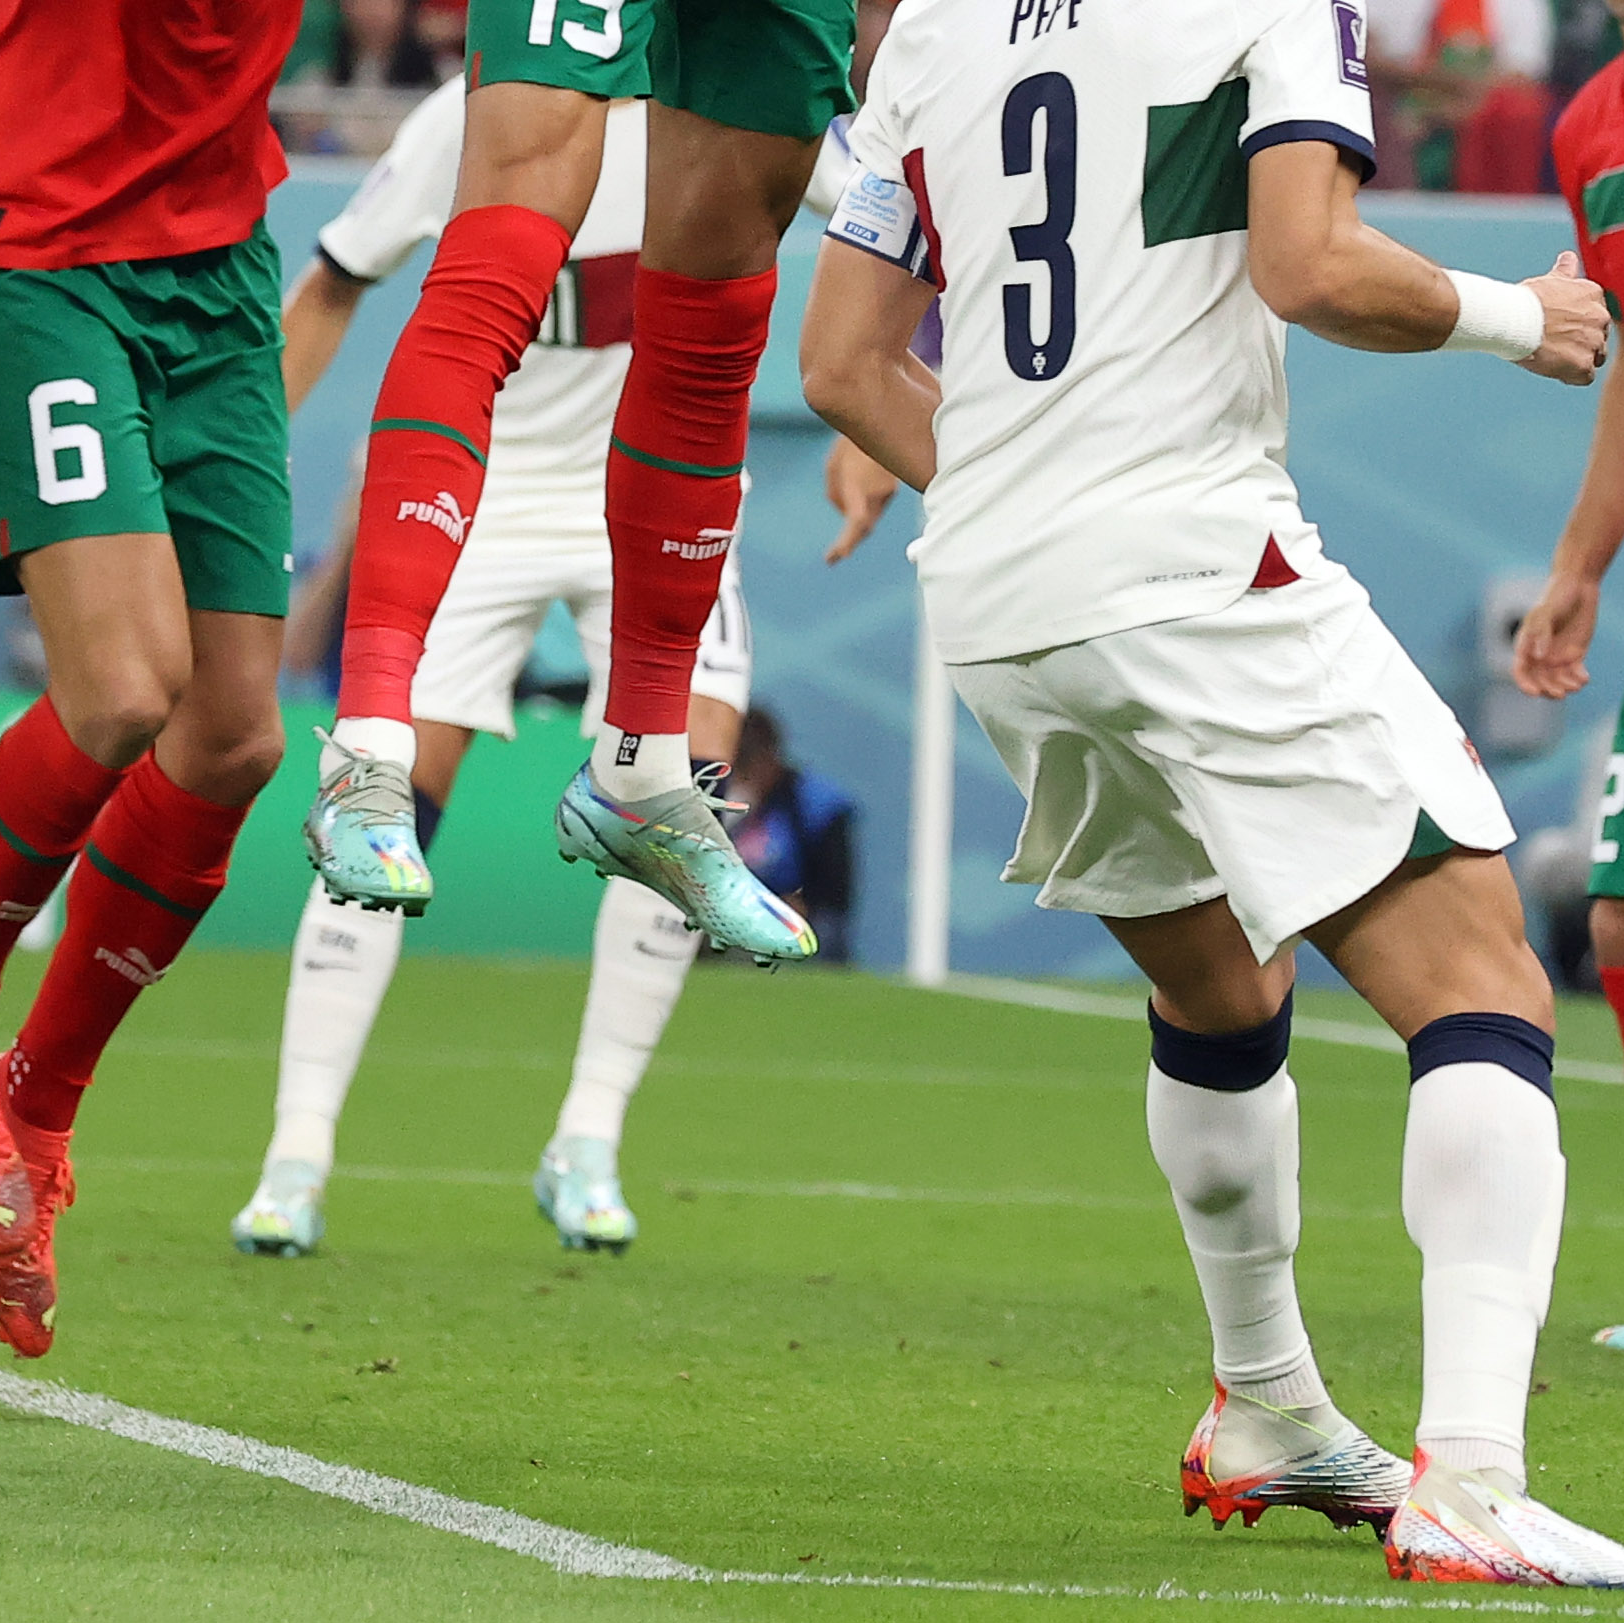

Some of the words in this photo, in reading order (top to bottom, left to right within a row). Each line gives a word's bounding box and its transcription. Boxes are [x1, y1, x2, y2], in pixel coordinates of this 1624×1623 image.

[846, 223, 873, 240] FIFA
[1001, 71, 1077, 381] 3
[28, 378, 108, 505] 6
[396, 500, 460, 544] PUMA
[617, 735, 639, 763] FS
